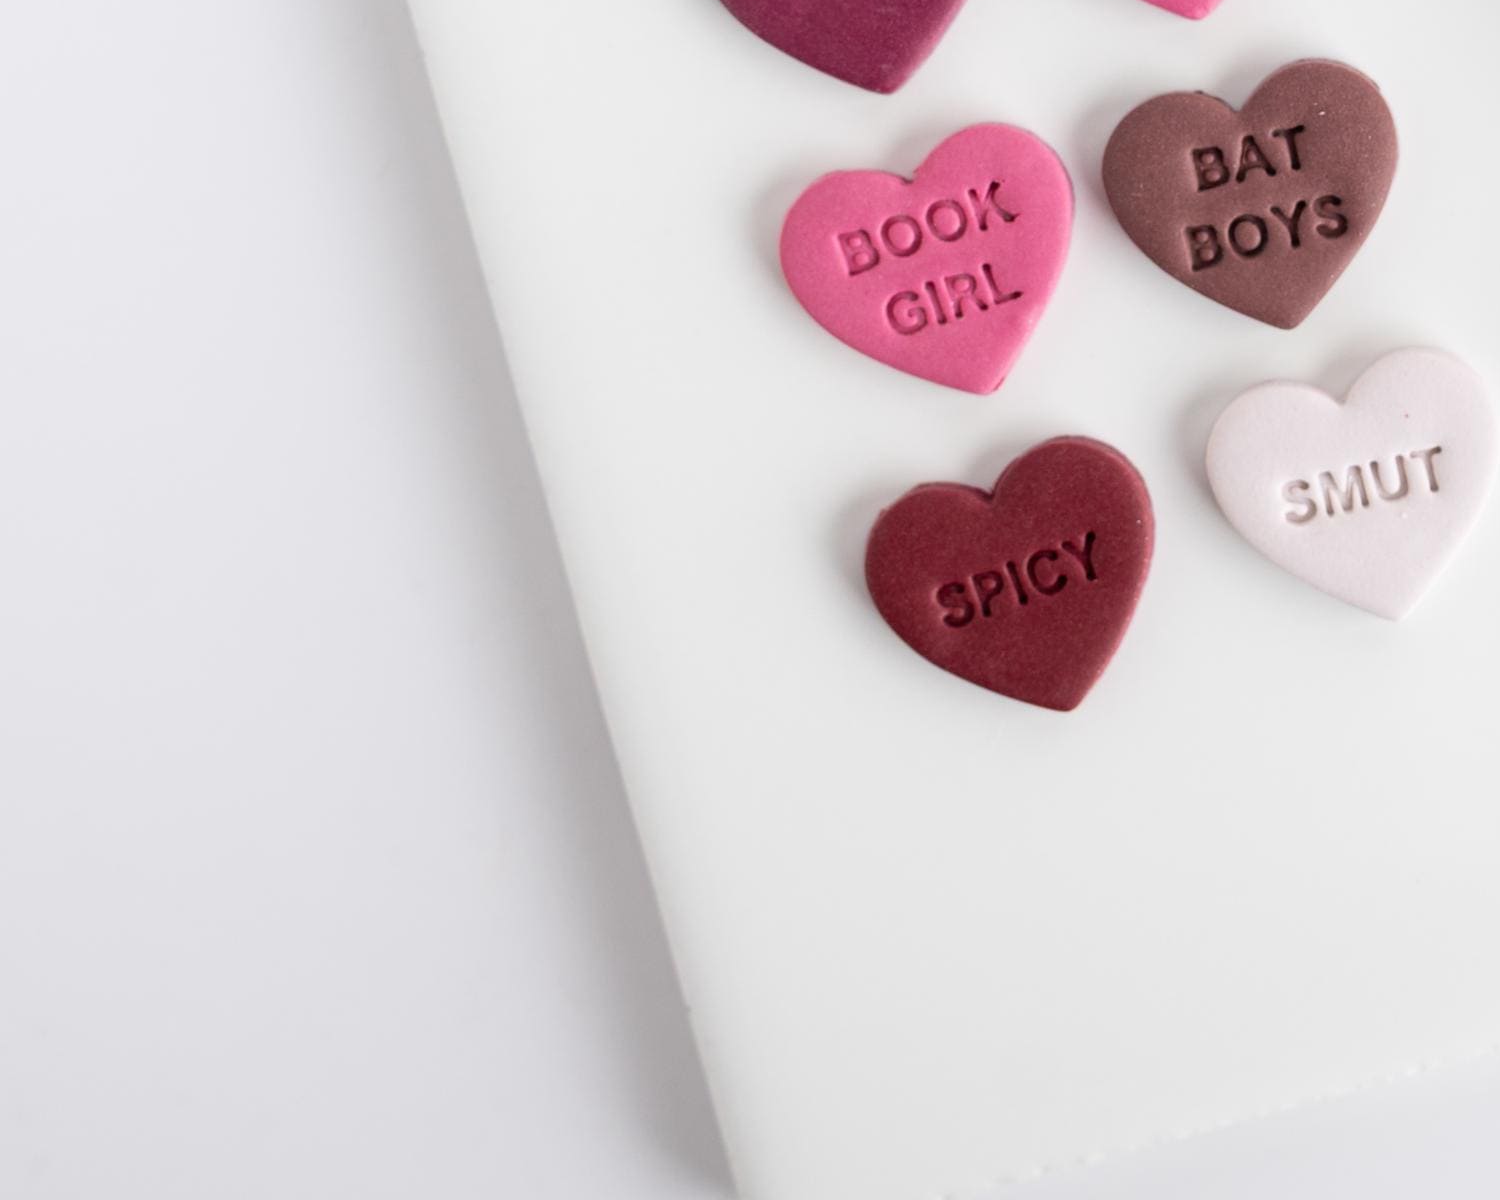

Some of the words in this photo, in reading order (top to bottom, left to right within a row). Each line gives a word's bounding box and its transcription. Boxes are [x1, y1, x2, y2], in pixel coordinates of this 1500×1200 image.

[1191, 124, 1306, 193] BAT
[836, 180, 1020, 277] BOOK
[1183, 194, 1350, 273] BOYS
[884, 262, 1023, 335] GIRL
[1283, 445, 1443, 526] SMUT
[935, 531, 1098, 629] SPICY
